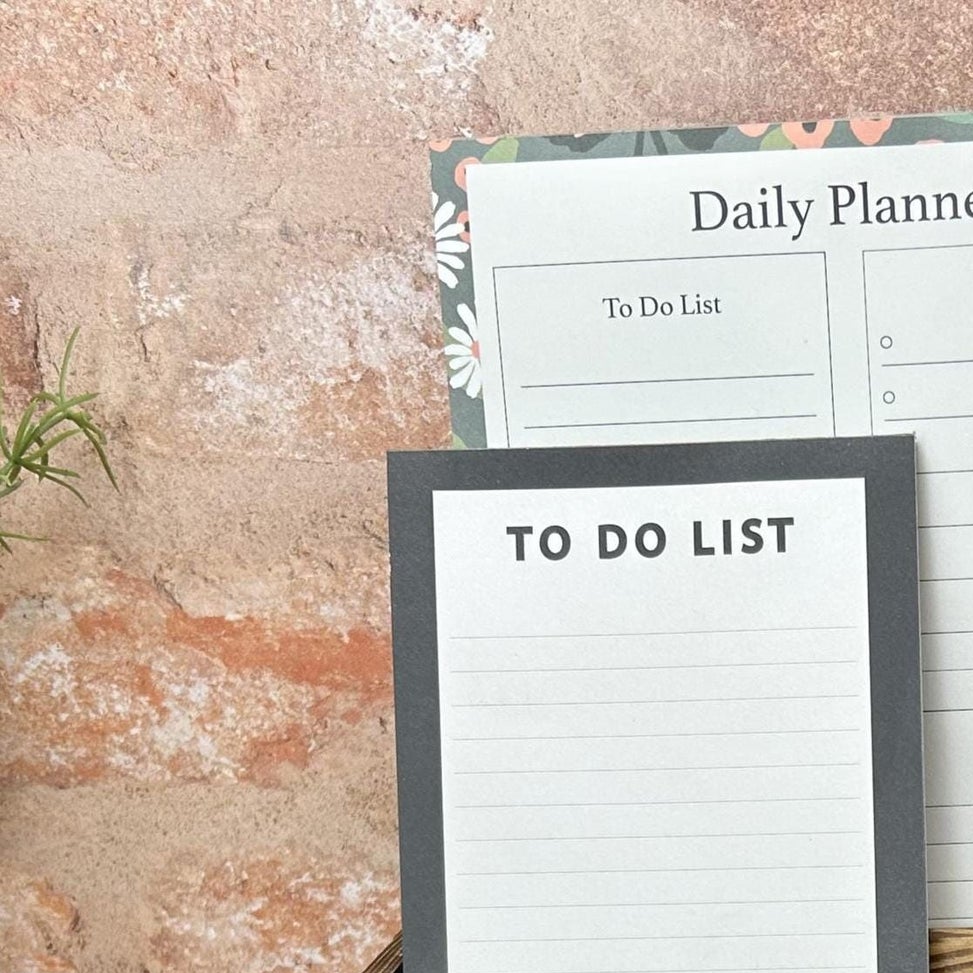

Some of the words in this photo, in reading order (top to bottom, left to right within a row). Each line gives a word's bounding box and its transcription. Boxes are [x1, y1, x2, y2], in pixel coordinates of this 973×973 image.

[690, 185, 814, 240] Daily
[603, 298, 632, 318] To
[640, 297, 673, 316] Do
[681, 294, 720, 314] List
[507, 526, 570, 560] TO
[598, 523, 666, 559] DO
[694, 517, 794, 556] LIST
